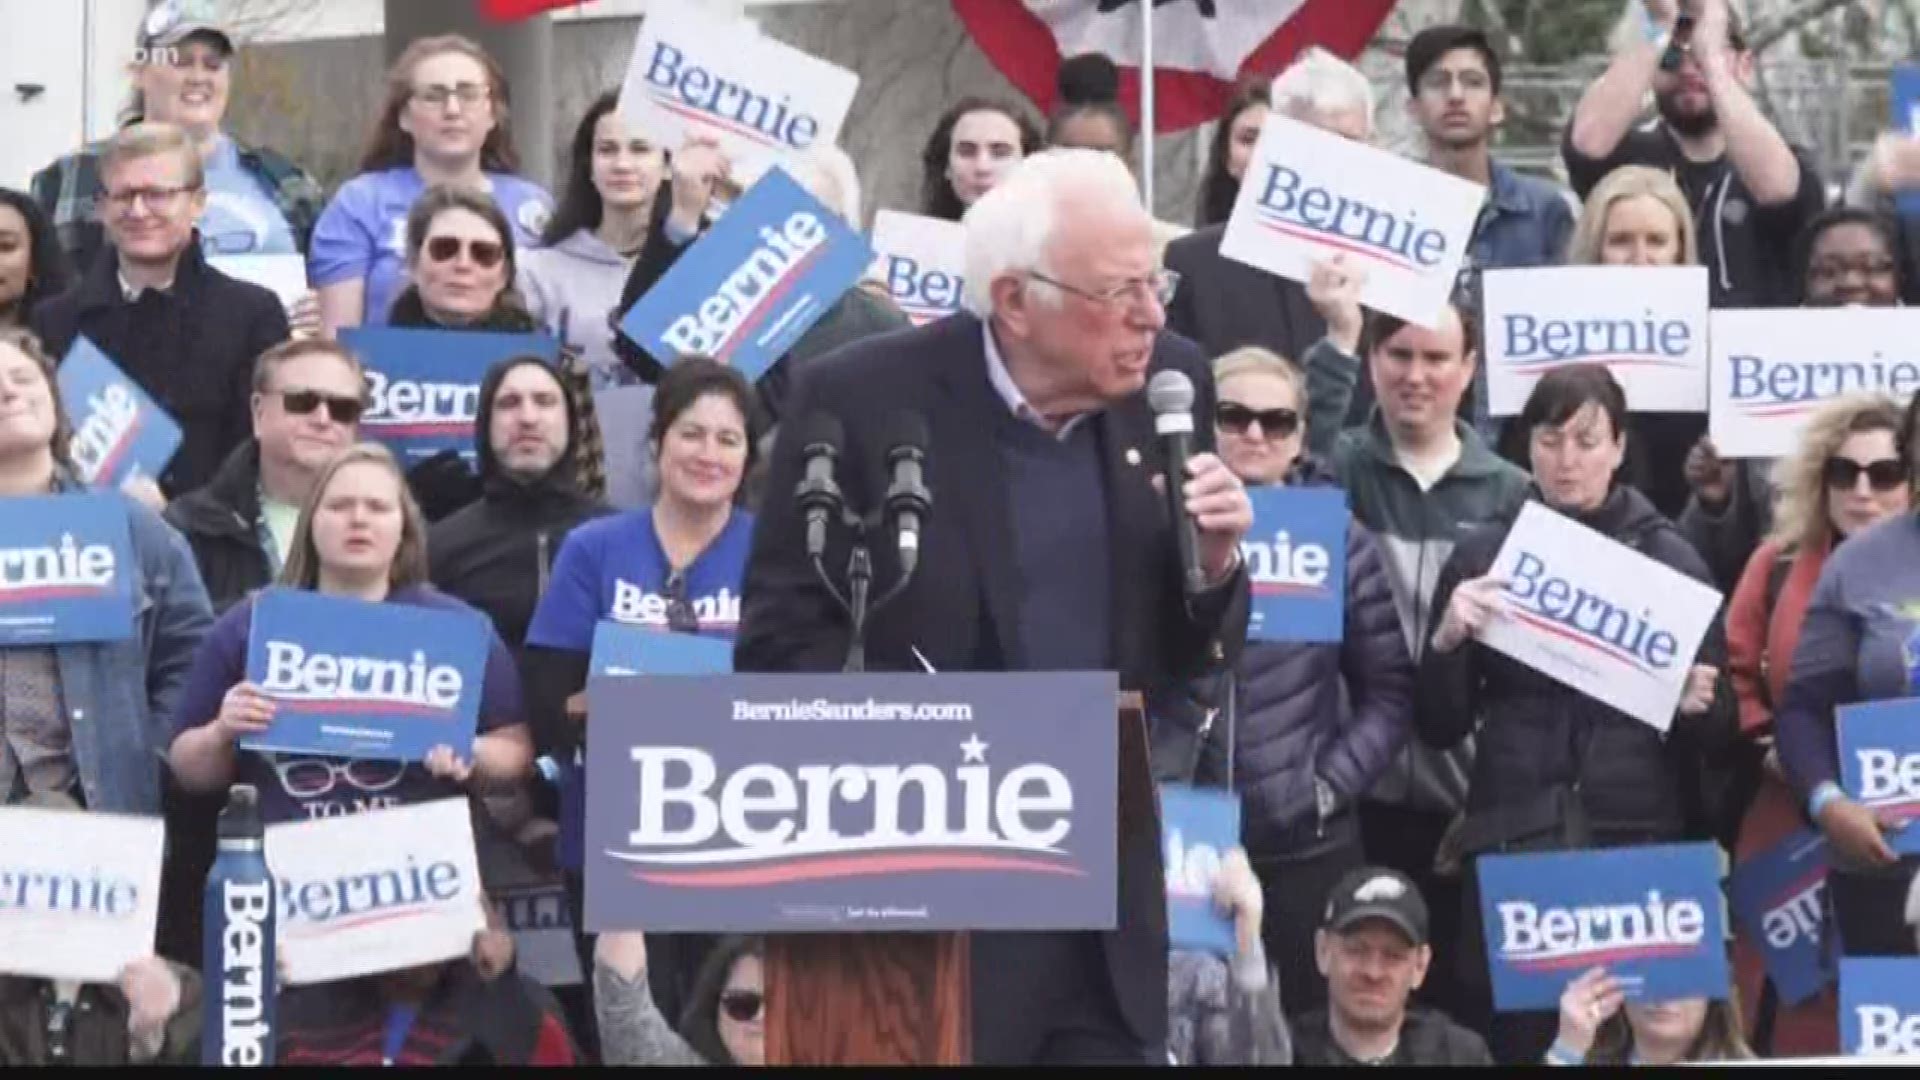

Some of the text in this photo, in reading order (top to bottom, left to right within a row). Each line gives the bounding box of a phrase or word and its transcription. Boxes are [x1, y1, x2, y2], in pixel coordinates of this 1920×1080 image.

[643, 41, 819, 149] Bernie
[1256, 163, 1447, 266] Bernie
[660, 210, 828, 353] Bernie
[1502, 307, 1692, 360] Bernie
[610, 576, 741, 625] Beni
[1503, 550, 1678, 669] Bernie
[262, 639, 464, 709] Bernie
[731, 698, 973, 722] BernieSanders.com
[628, 732, 1074, 849] Bernie
[1496, 889, 1706, 952] Bernie
[221, 878, 270, 1067] Bernie
